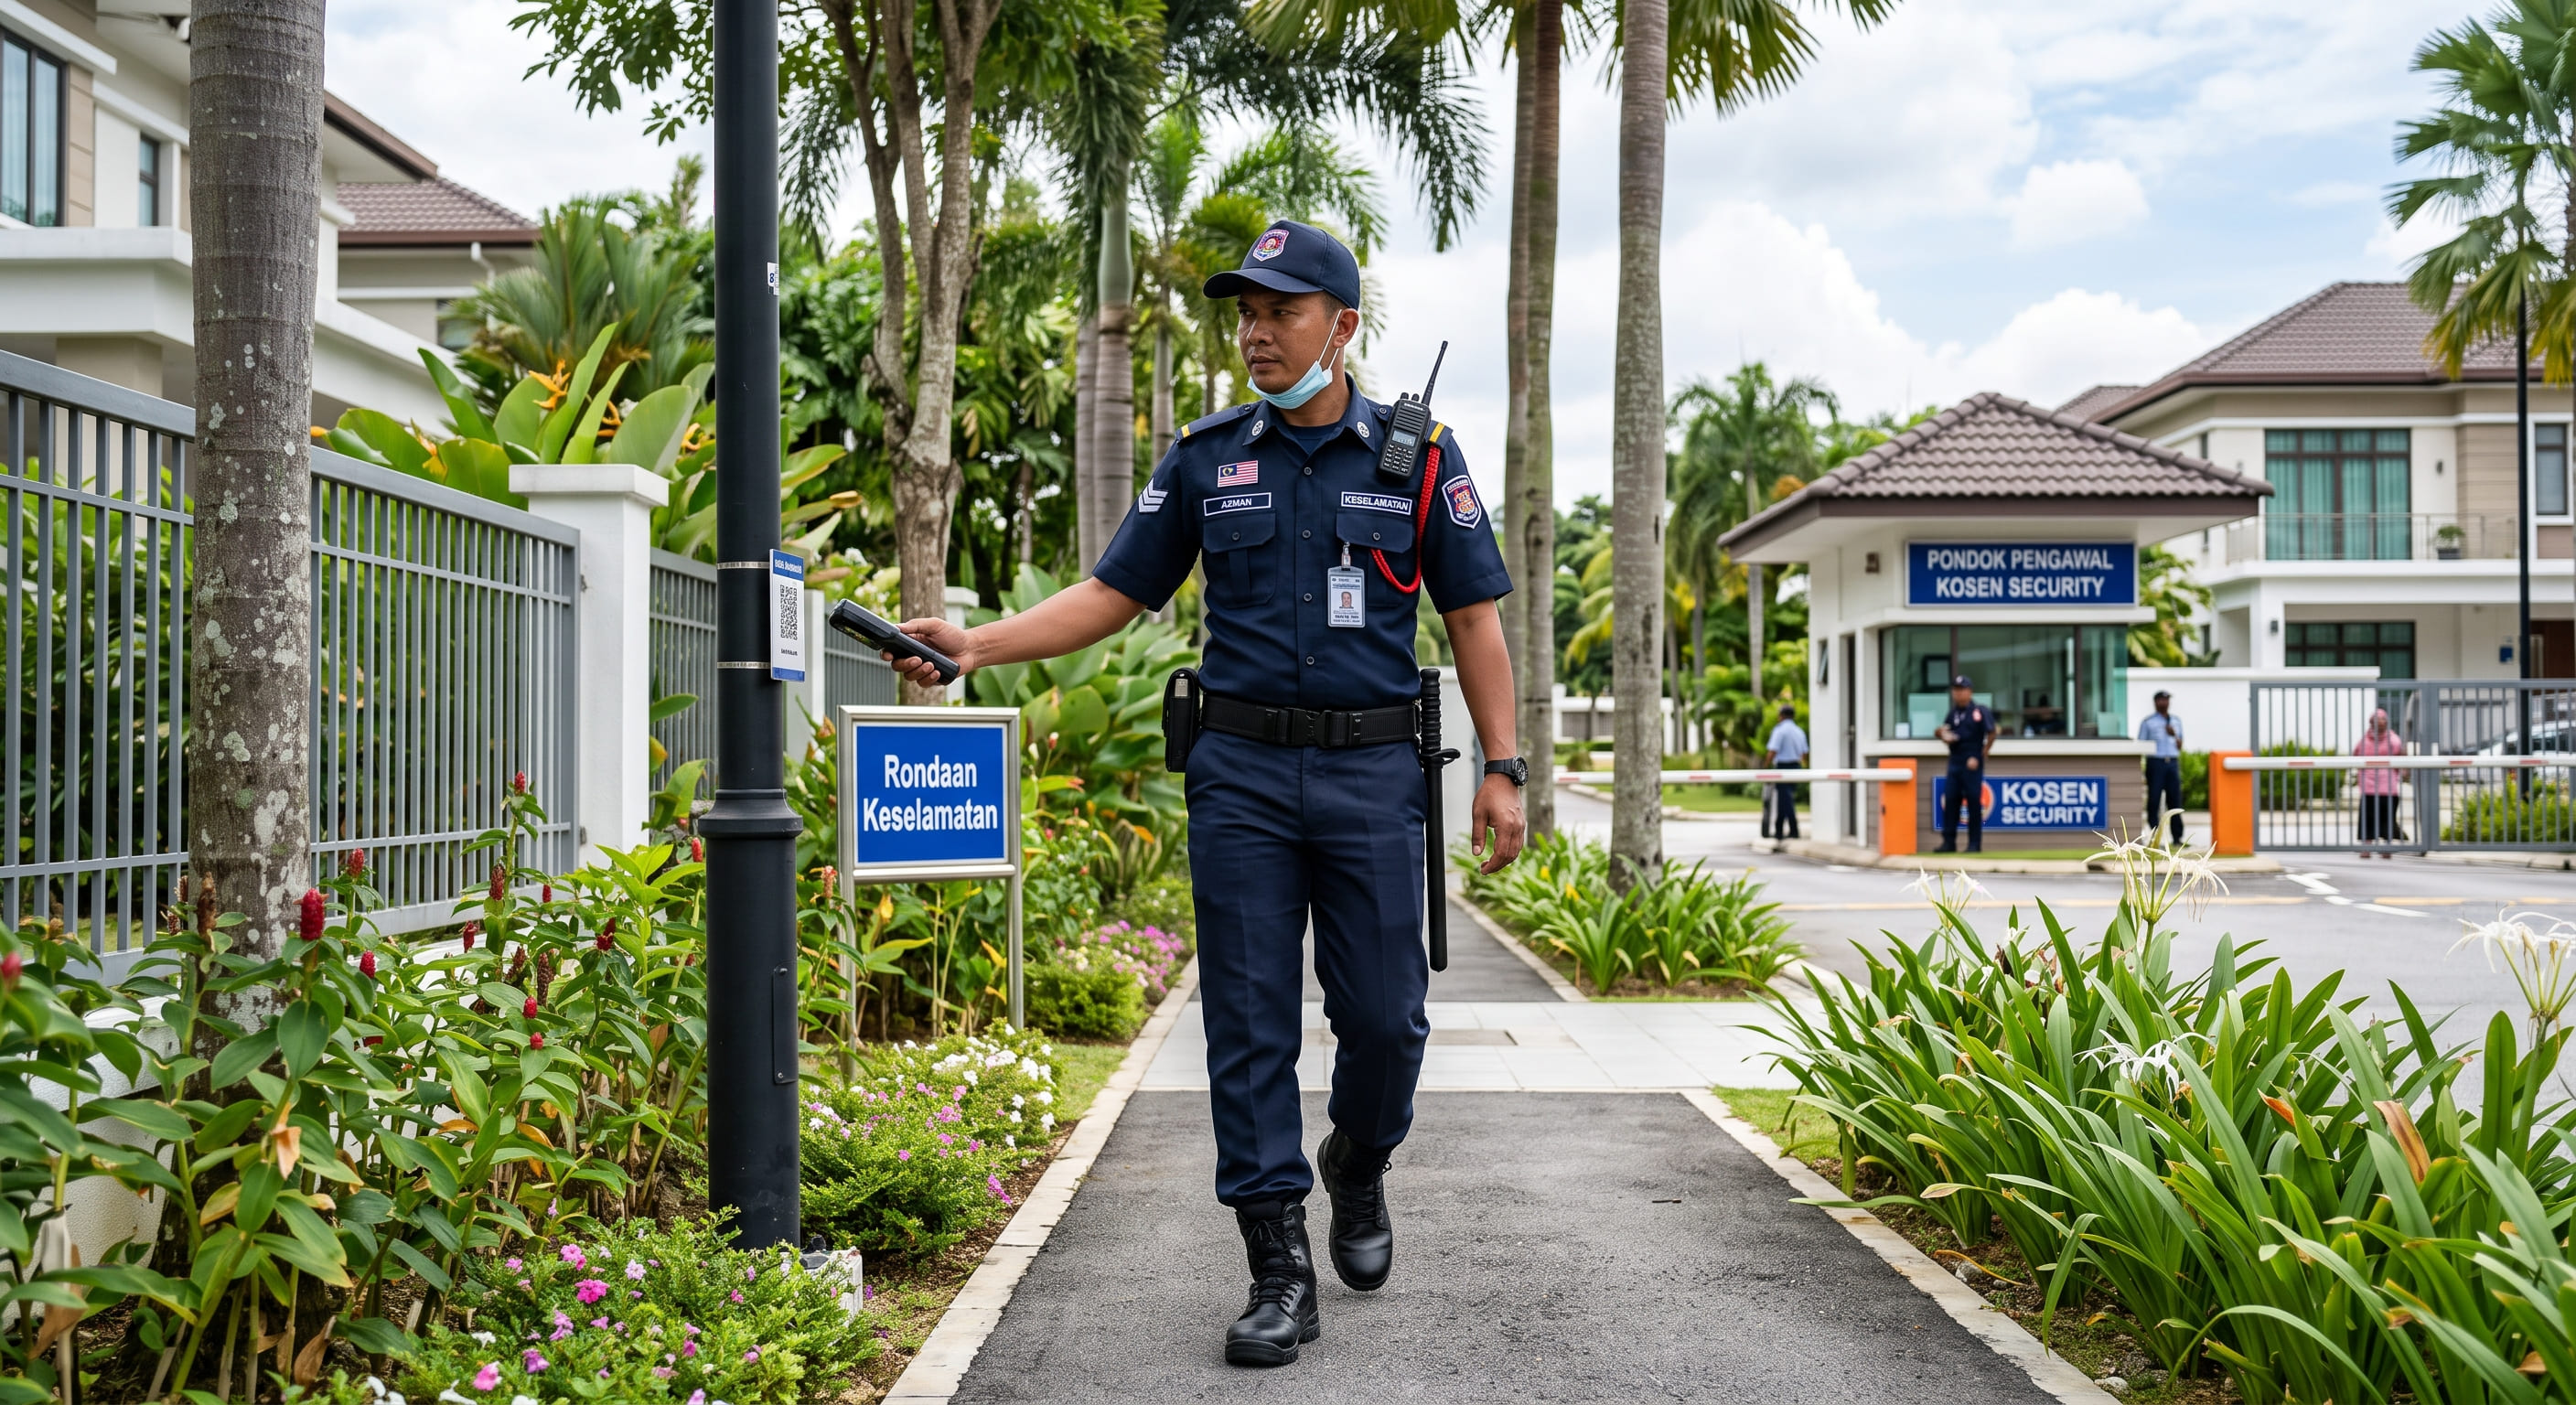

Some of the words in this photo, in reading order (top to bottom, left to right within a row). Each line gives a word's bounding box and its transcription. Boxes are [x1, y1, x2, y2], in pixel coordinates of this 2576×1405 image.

[1345, 495, 1409, 511] KESELAMATAN
[1927, 549, 2006, 570] PONDOK
[2011, 549, 2114, 570] PENGAWAL
[1936, 576, 2003, 598] KOSEN
[2008, 576, 2105, 598] SECURITY
[885, 754, 977, 788] Rondaan
[2002, 781, 2098, 806] KOSEN
[863, 797, 998, 832] Keselamatan
[2001, 806, 2098, 824] SECURITY
